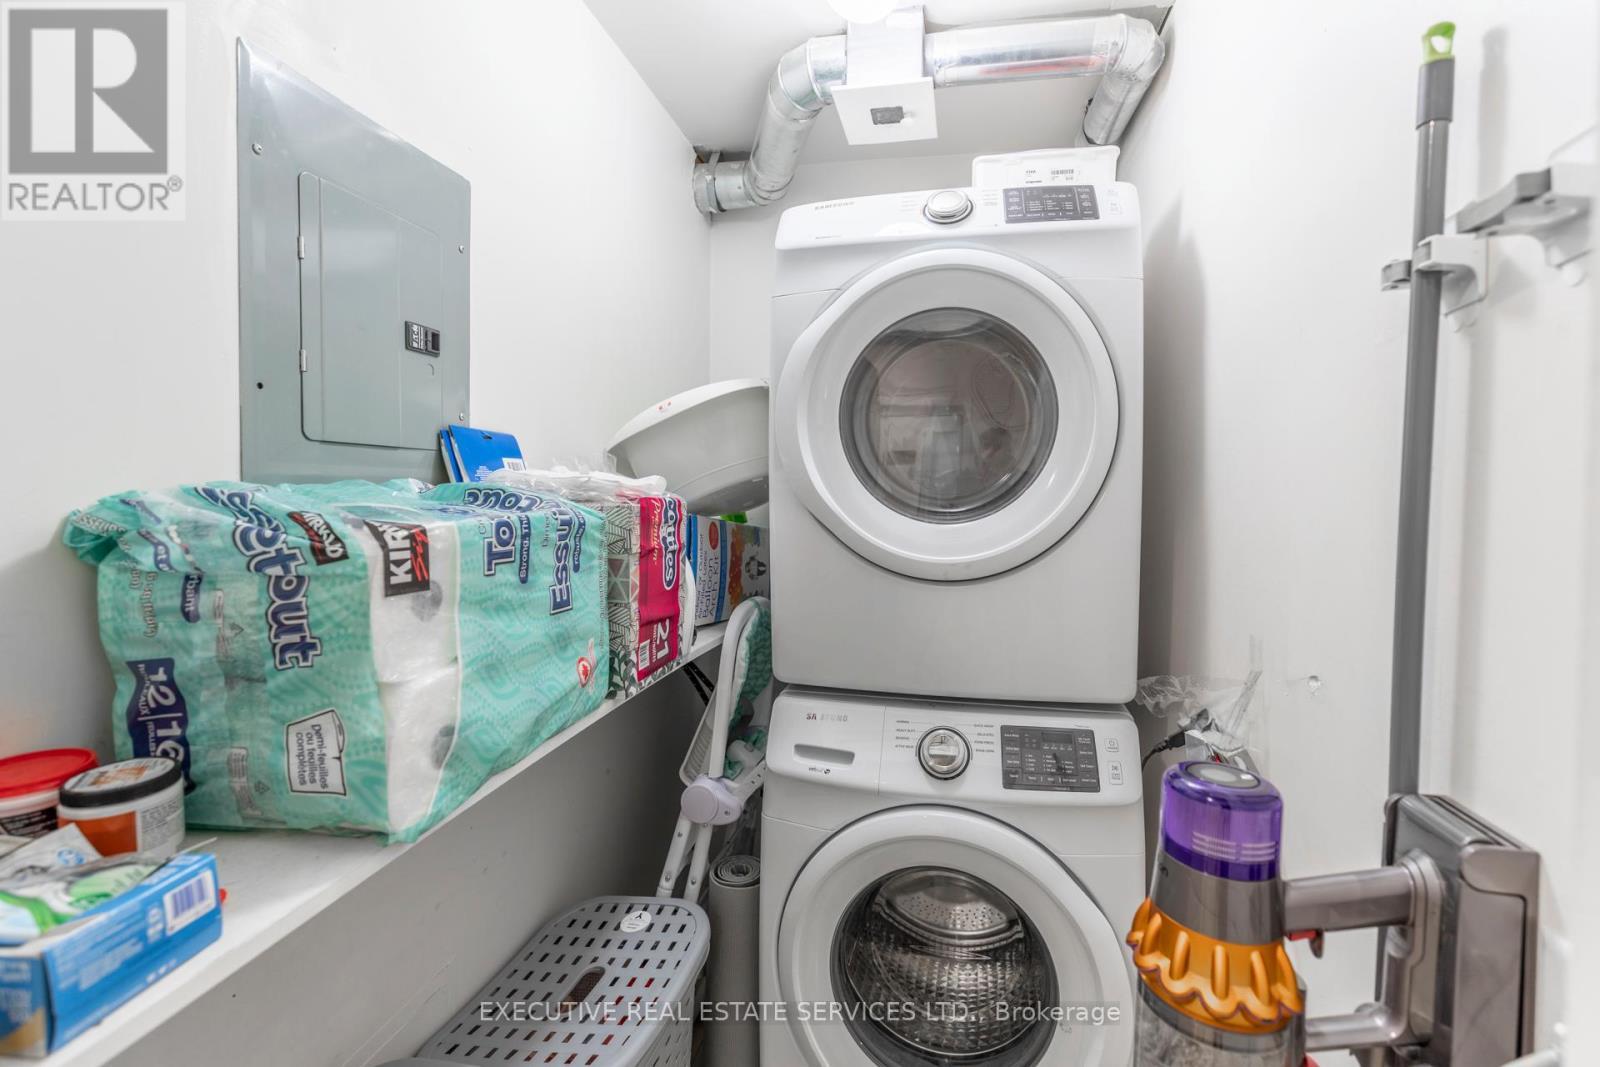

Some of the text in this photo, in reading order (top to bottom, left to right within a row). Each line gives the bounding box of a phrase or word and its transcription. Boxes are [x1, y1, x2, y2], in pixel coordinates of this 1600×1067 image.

[702, 558, 714, 618] Balloon
[655, 618, 671, 660] 21
[147, 667, 177, 708] 12
[305, 732, 319, 785] ou feuilles
[311, 723, 329, 790] Demi-feuilles
